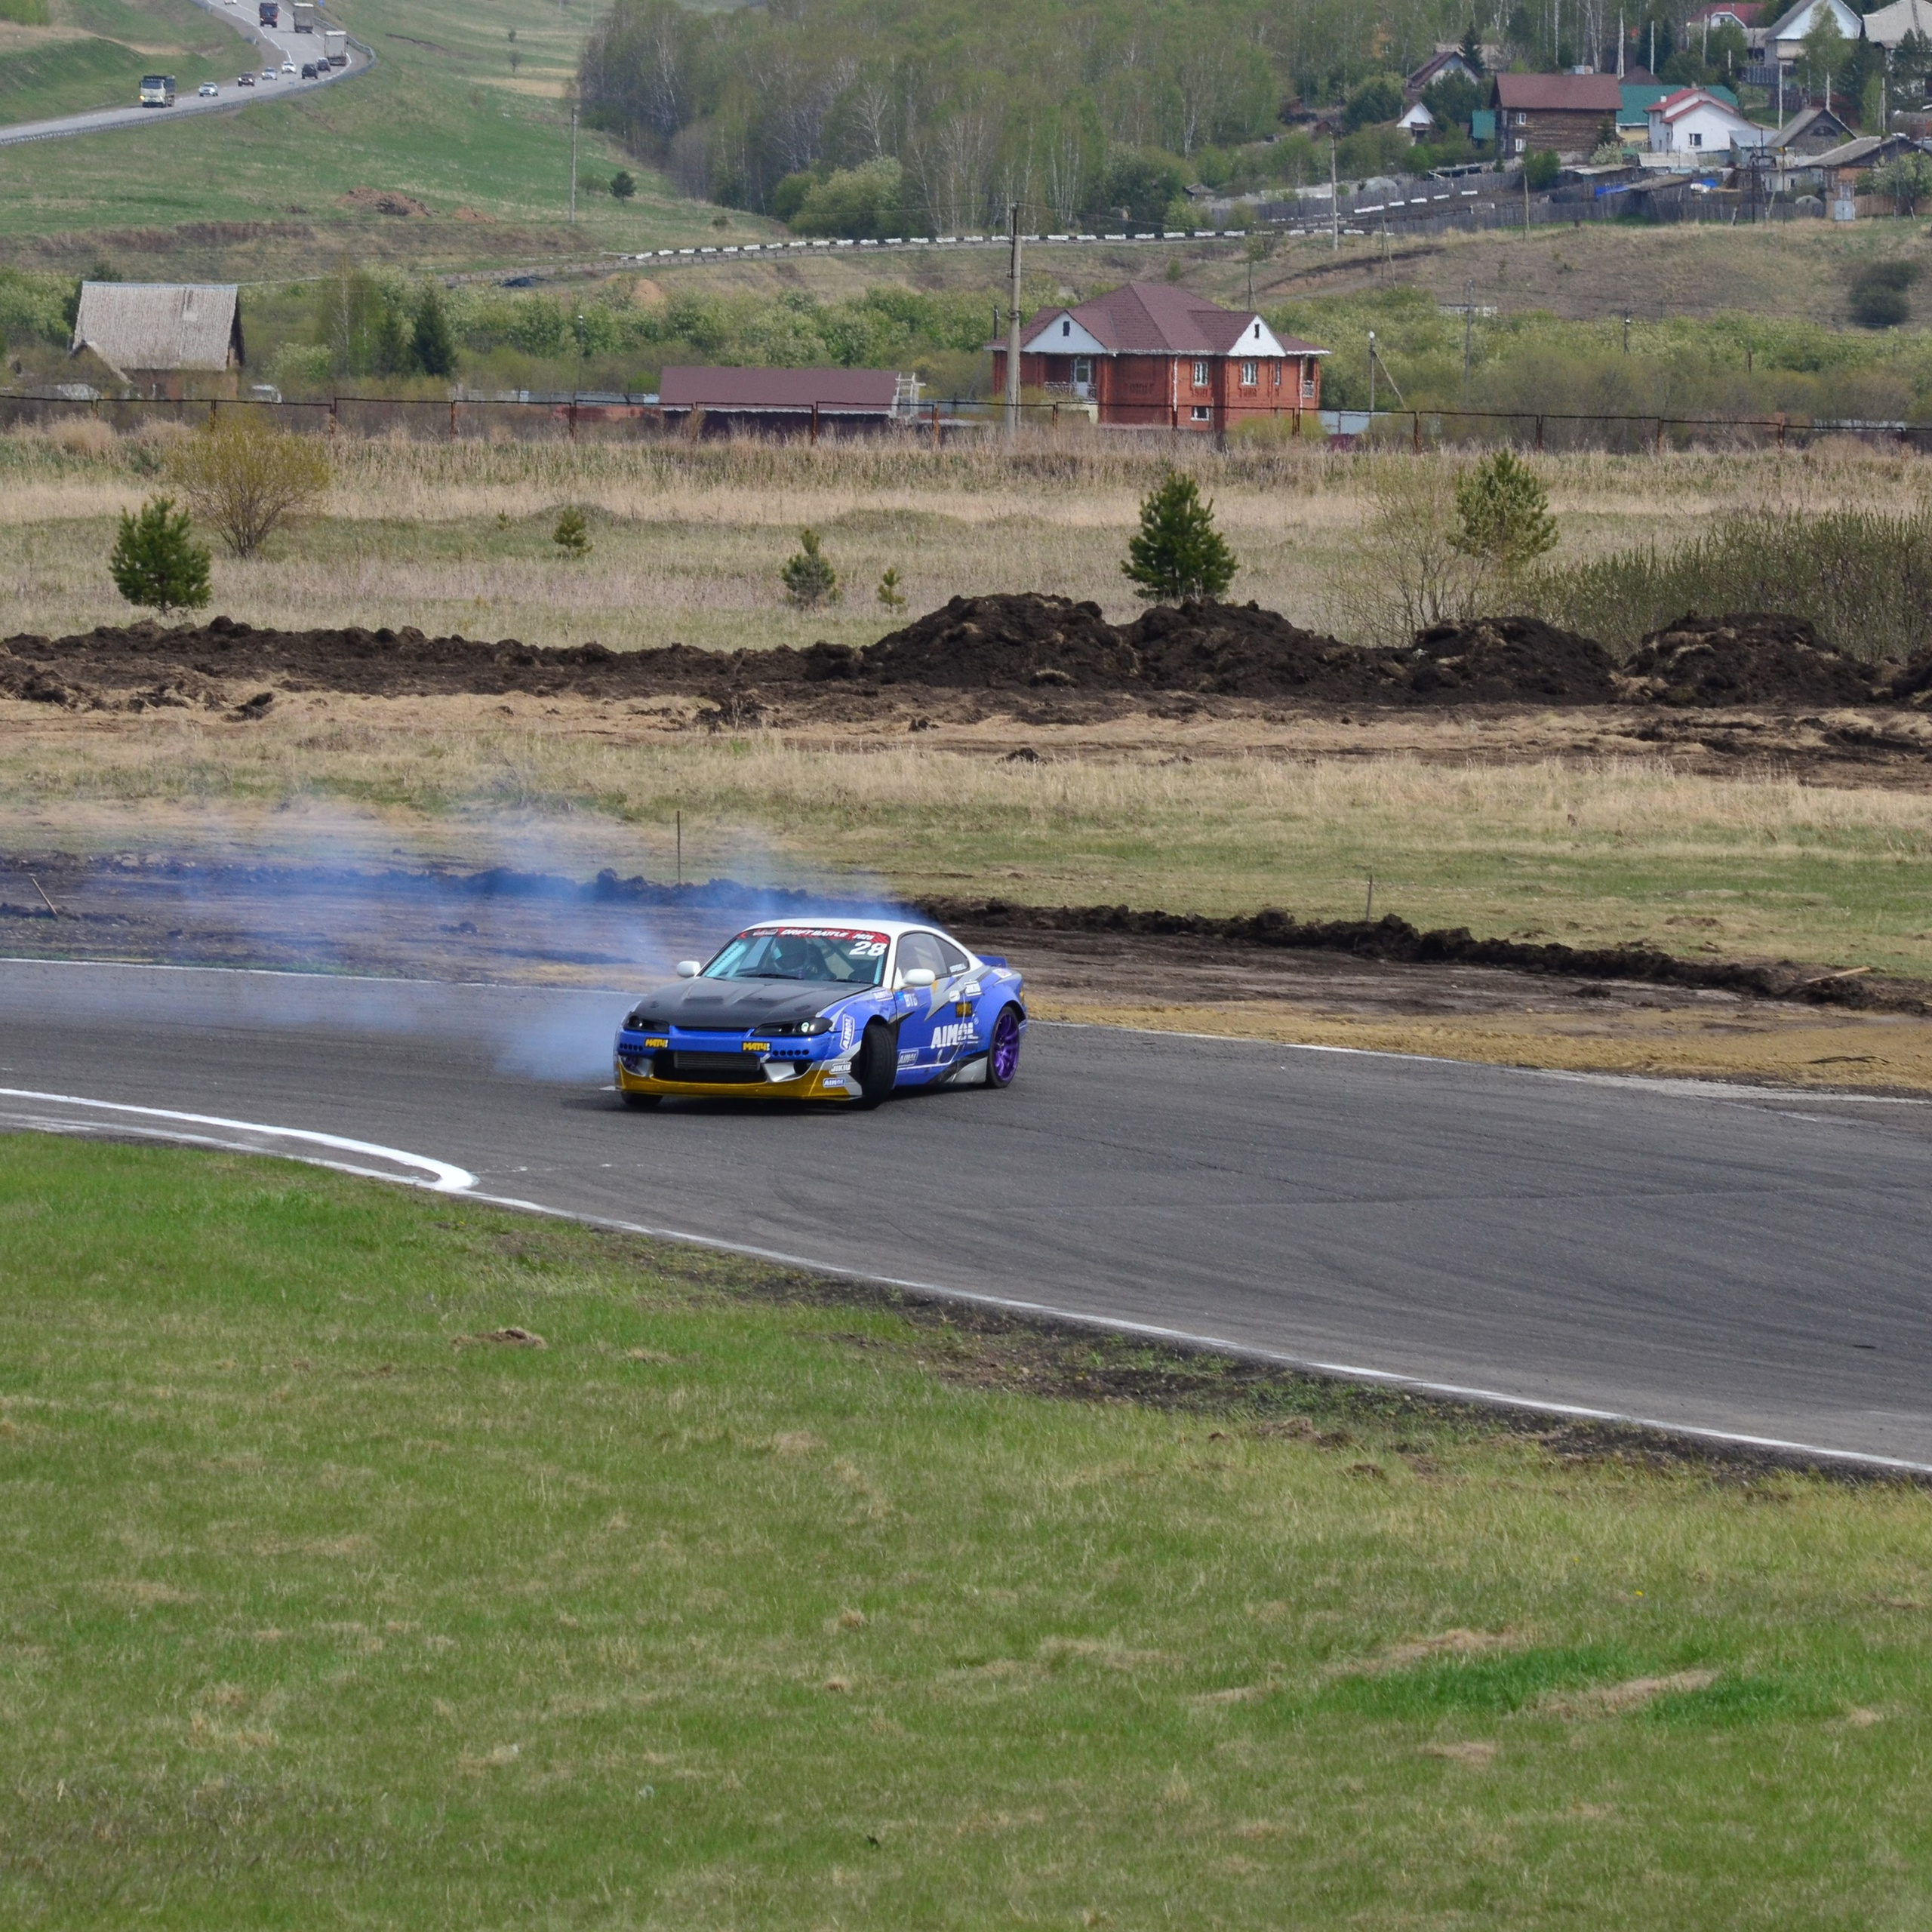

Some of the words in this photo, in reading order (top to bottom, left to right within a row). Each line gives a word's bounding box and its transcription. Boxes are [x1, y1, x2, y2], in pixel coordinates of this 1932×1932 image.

[849, 941, 887, 956] 28
[842, 1018, 853, 1050] AIMOL
[931, 1022, 979, 1049] AIMOL
